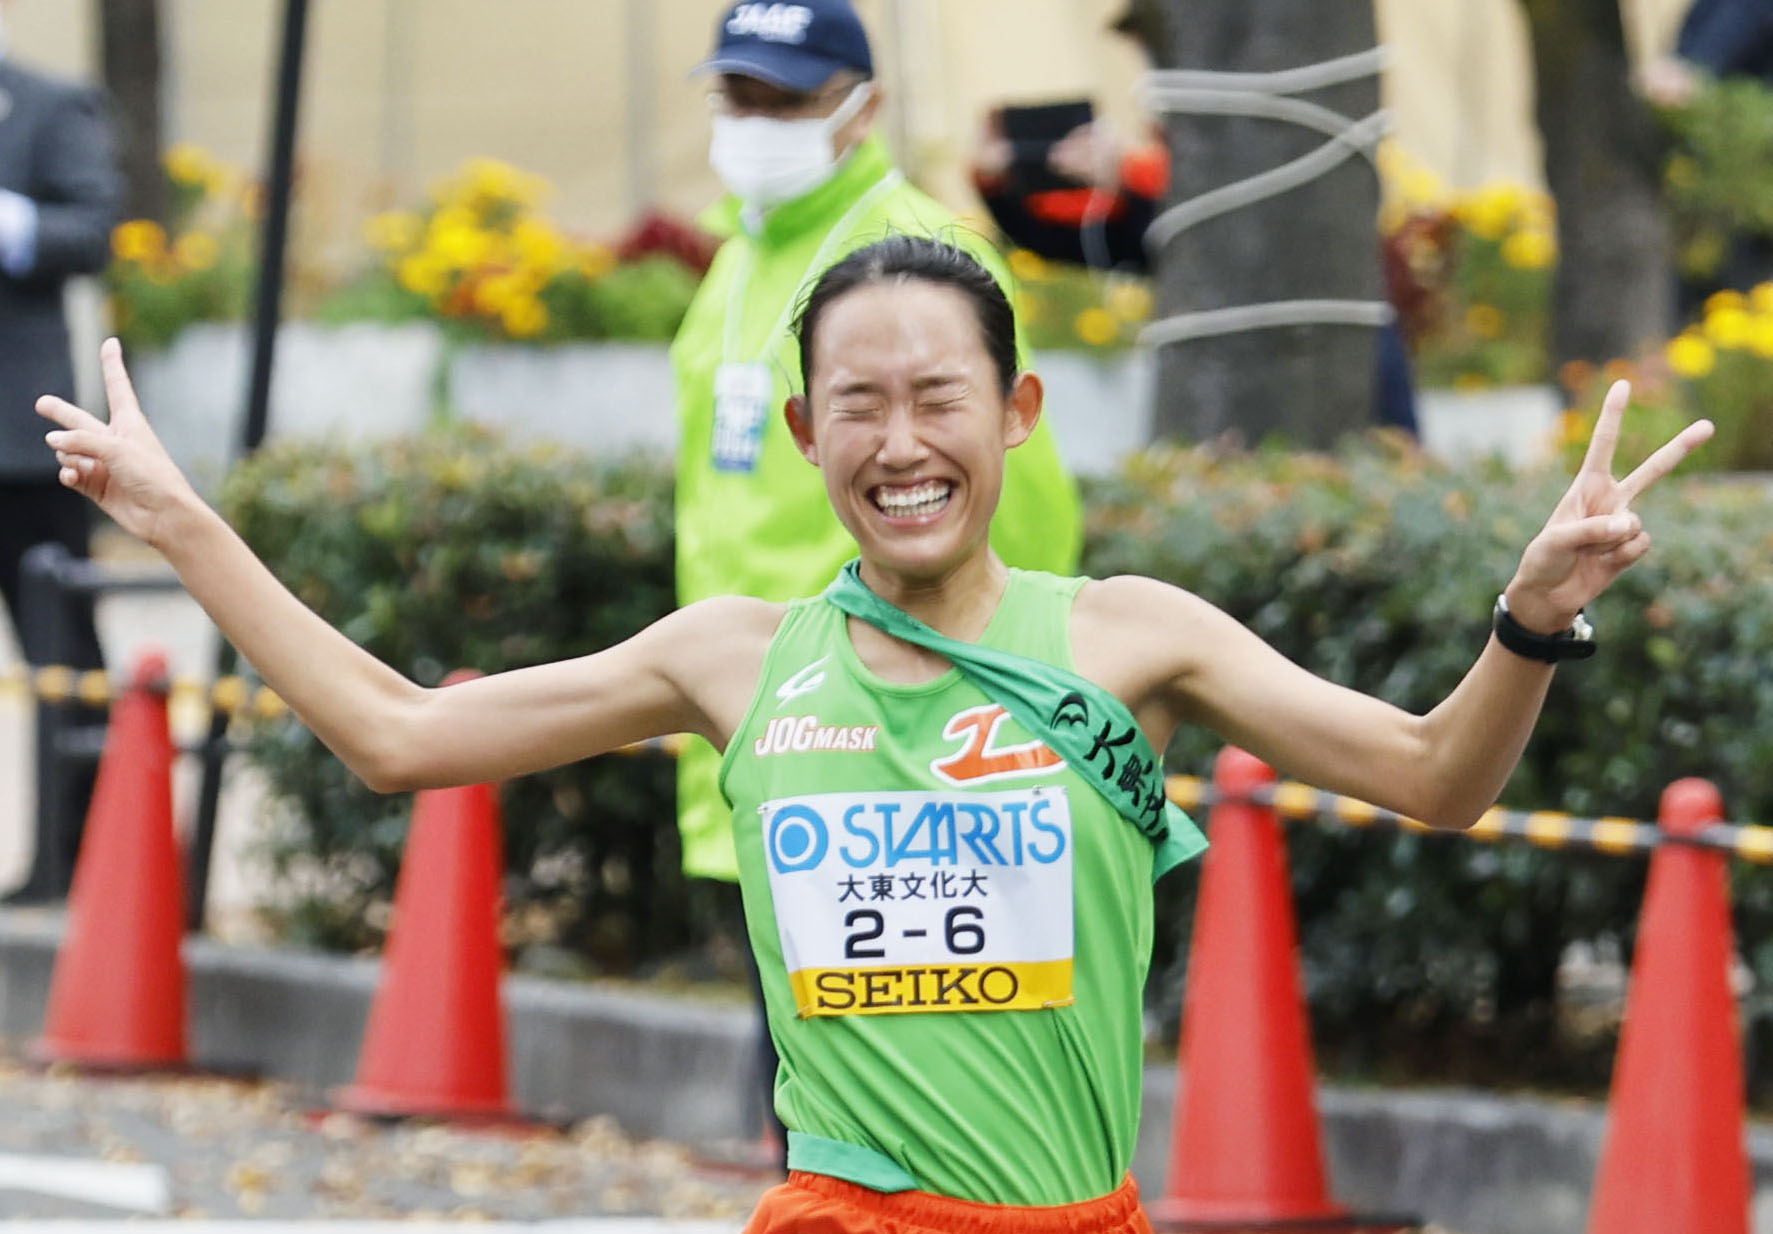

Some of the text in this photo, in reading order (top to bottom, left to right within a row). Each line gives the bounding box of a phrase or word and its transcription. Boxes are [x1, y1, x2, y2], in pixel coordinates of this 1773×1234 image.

[755, 715, 878, 756] JOGMASK
[838, 870, 988, 902] 大東文化大
[816, 968, 1018, 1009] SEIKO
